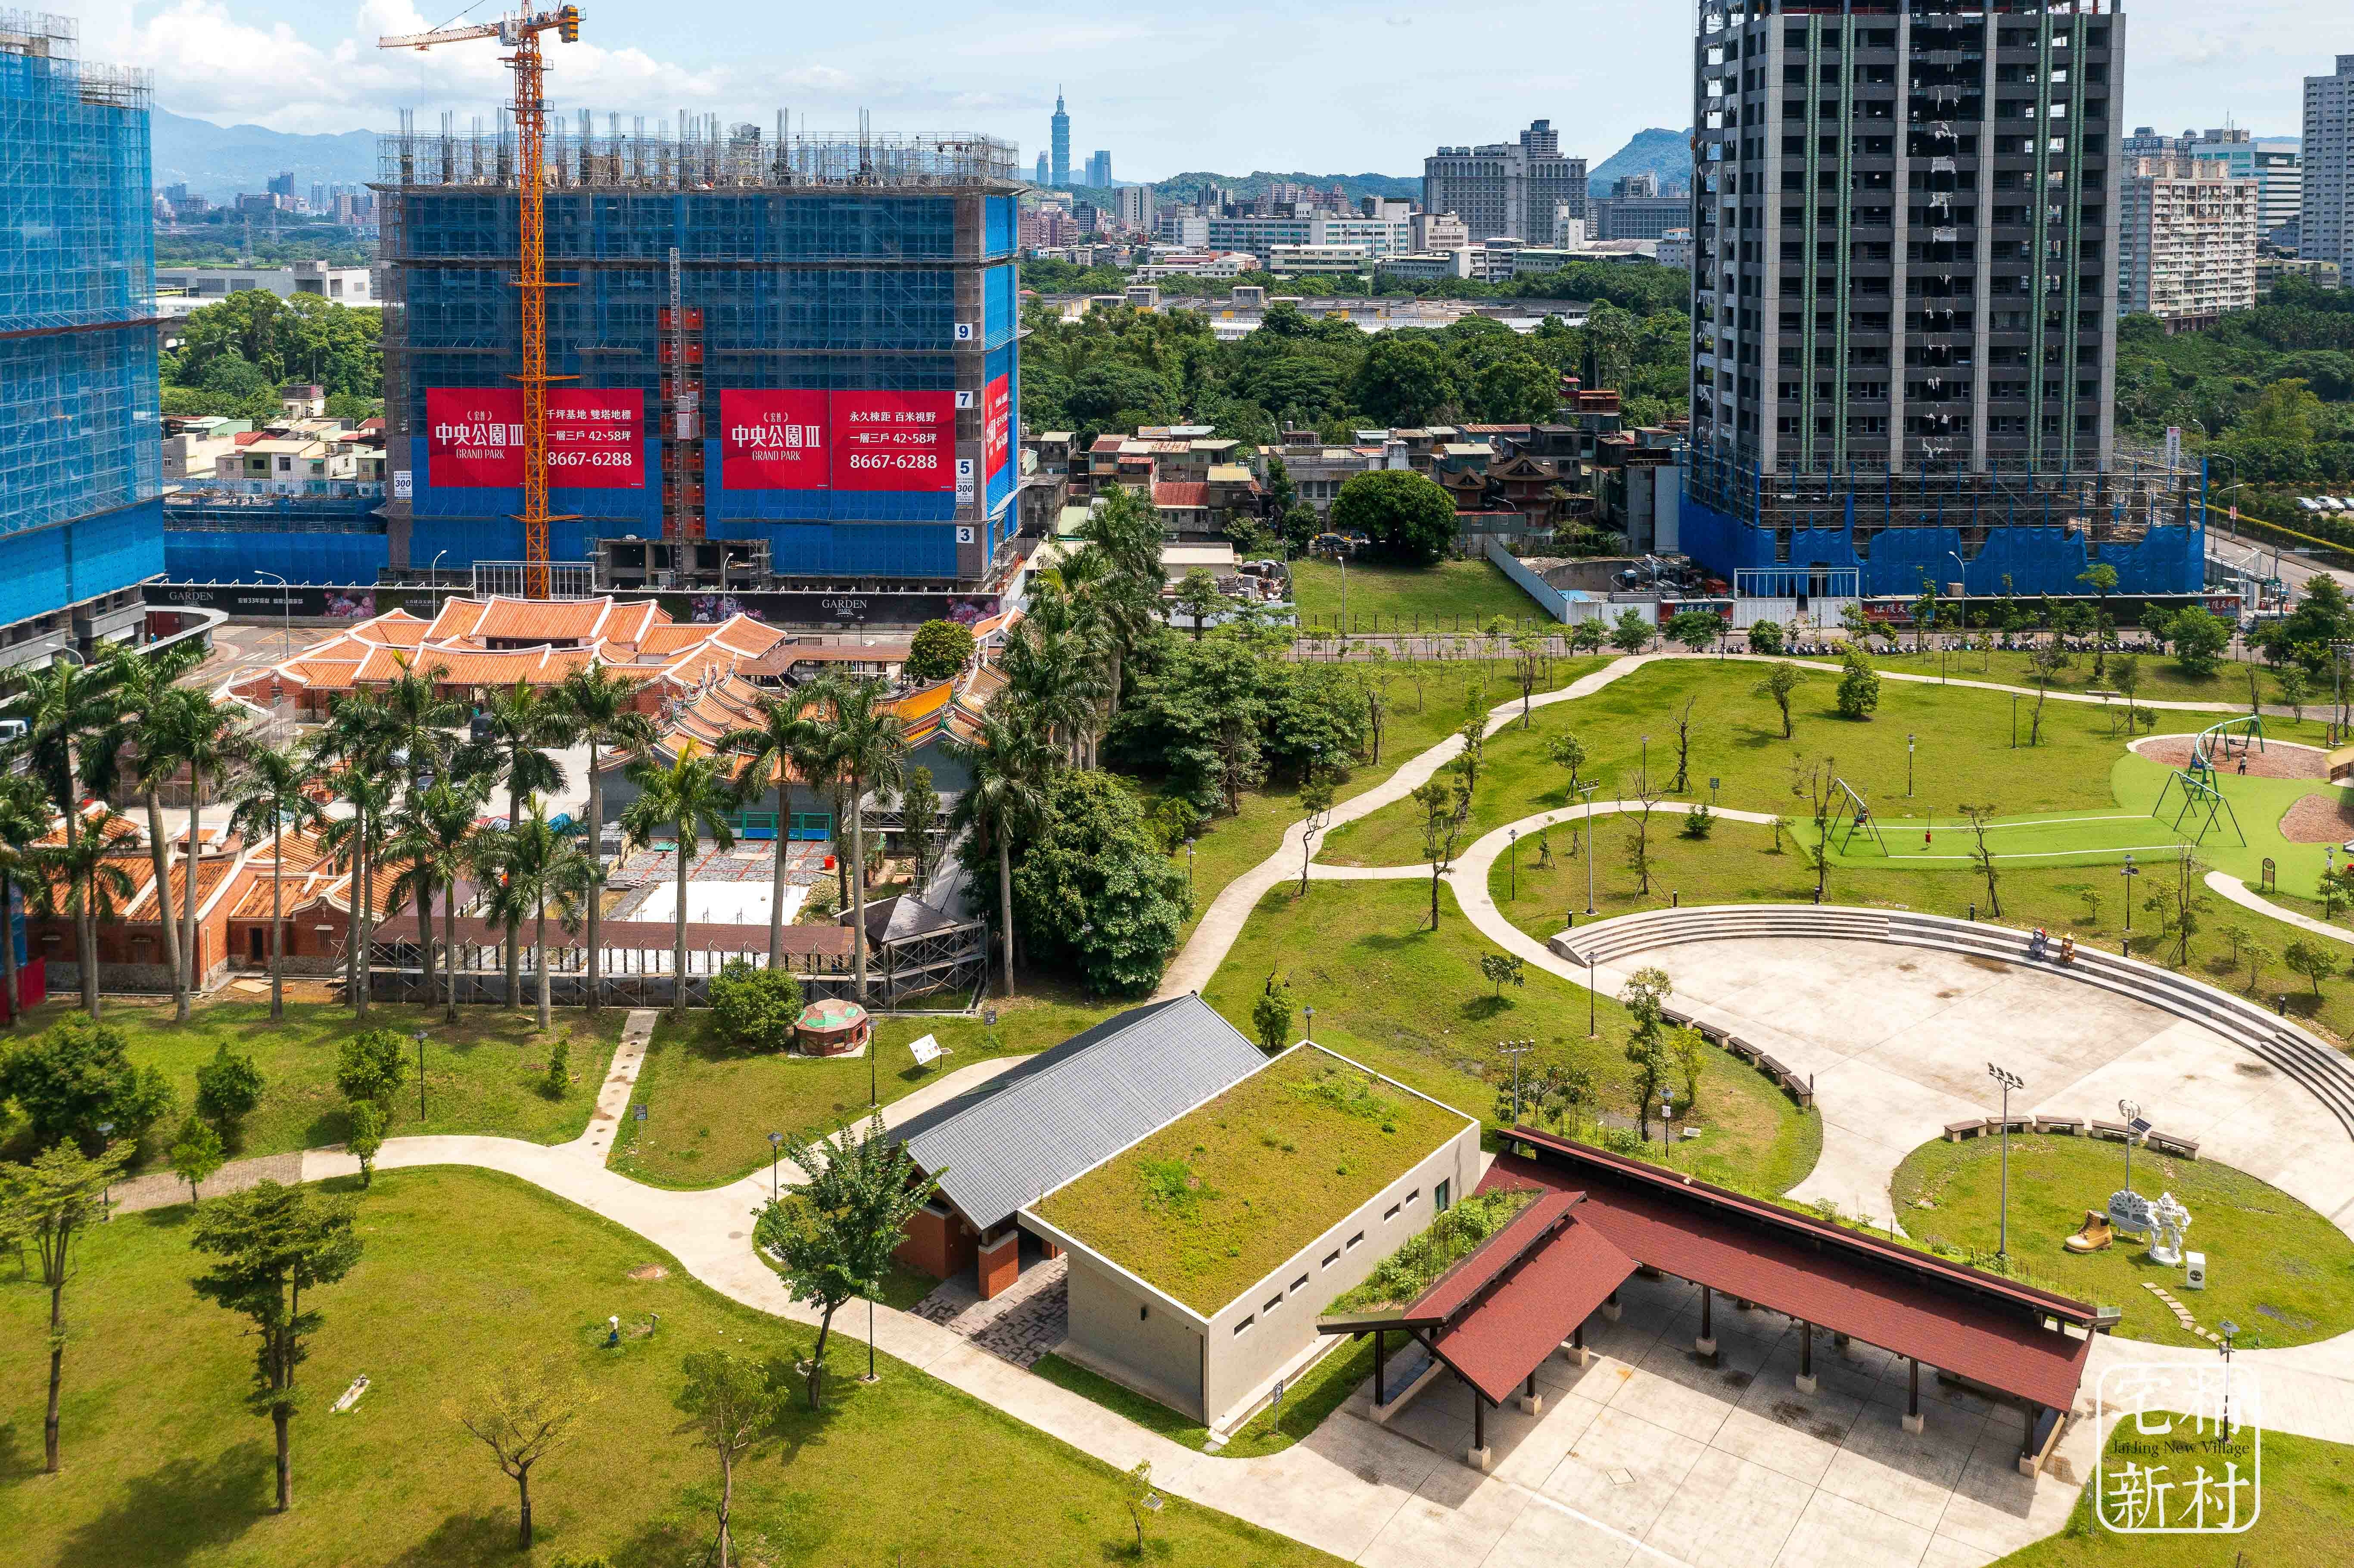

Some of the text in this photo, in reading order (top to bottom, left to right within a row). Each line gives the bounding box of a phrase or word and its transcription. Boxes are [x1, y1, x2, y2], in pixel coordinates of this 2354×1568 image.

[959, 326, 968, 338] 9
[960, 393, 968, 406] 7
[546, 410, 631, 420] 千坪基地 雙塔地標
[849, 411, 936, 422] 永久棟距 百米視野
[547, 431, 585, 441] 一層三戶
[850, 433, 889, 443] 一層三戶
[456, 448, 505, 459] GRAND PARK
[548, 452, 632, 466] 8667-6288
[752, 451, 801, 461] GRAND PARK
[850, 454, 937, 469] 8667-6288
[960, 461, 969, 474] 5
[960, 528, 970, 541] 3
[169, 592, 214, 600] GARDEN
[822, 599, 867, 608] GARDEN
[1874, 604, 1911, 613] 江陵天
